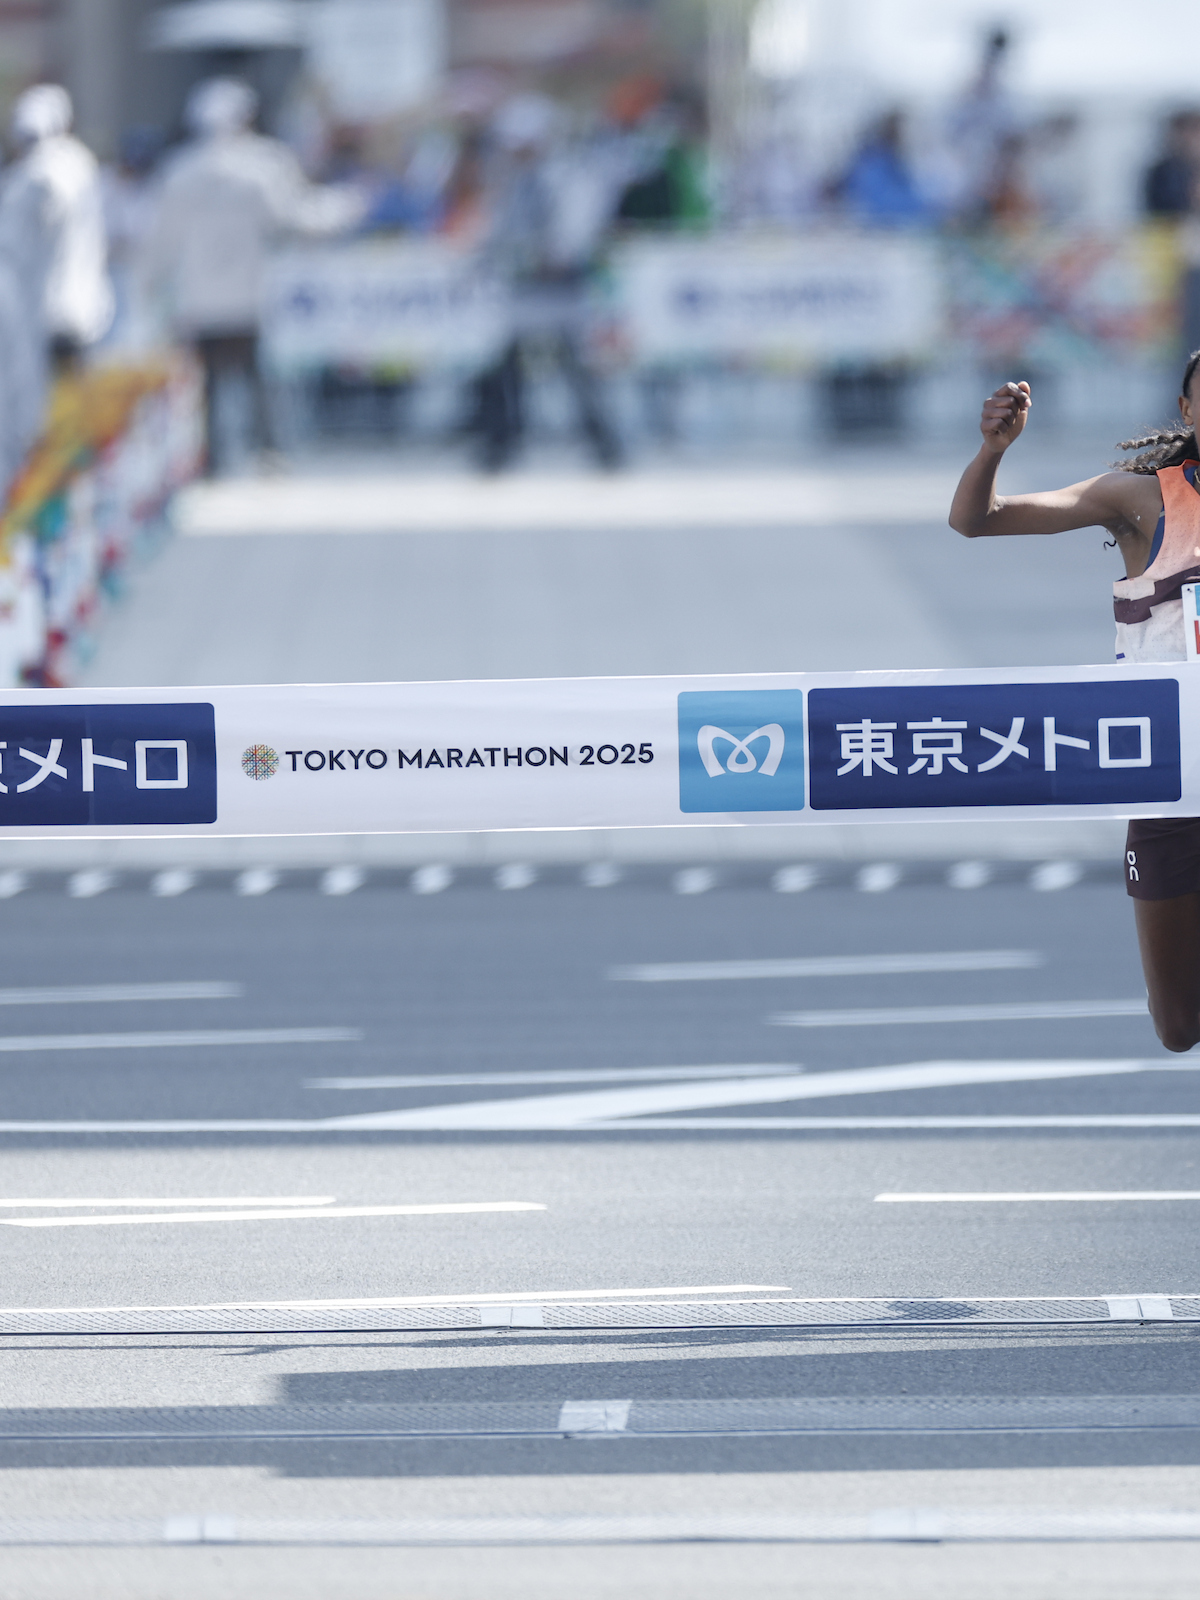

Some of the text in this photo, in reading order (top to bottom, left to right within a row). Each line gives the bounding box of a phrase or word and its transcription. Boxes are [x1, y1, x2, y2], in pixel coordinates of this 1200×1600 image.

[0, 738, 189, 794] メトロ
[284, 742, 655, 772] TOKYO MARATHON 2025
[836, 716, 1152, 777] 東京メトロ
